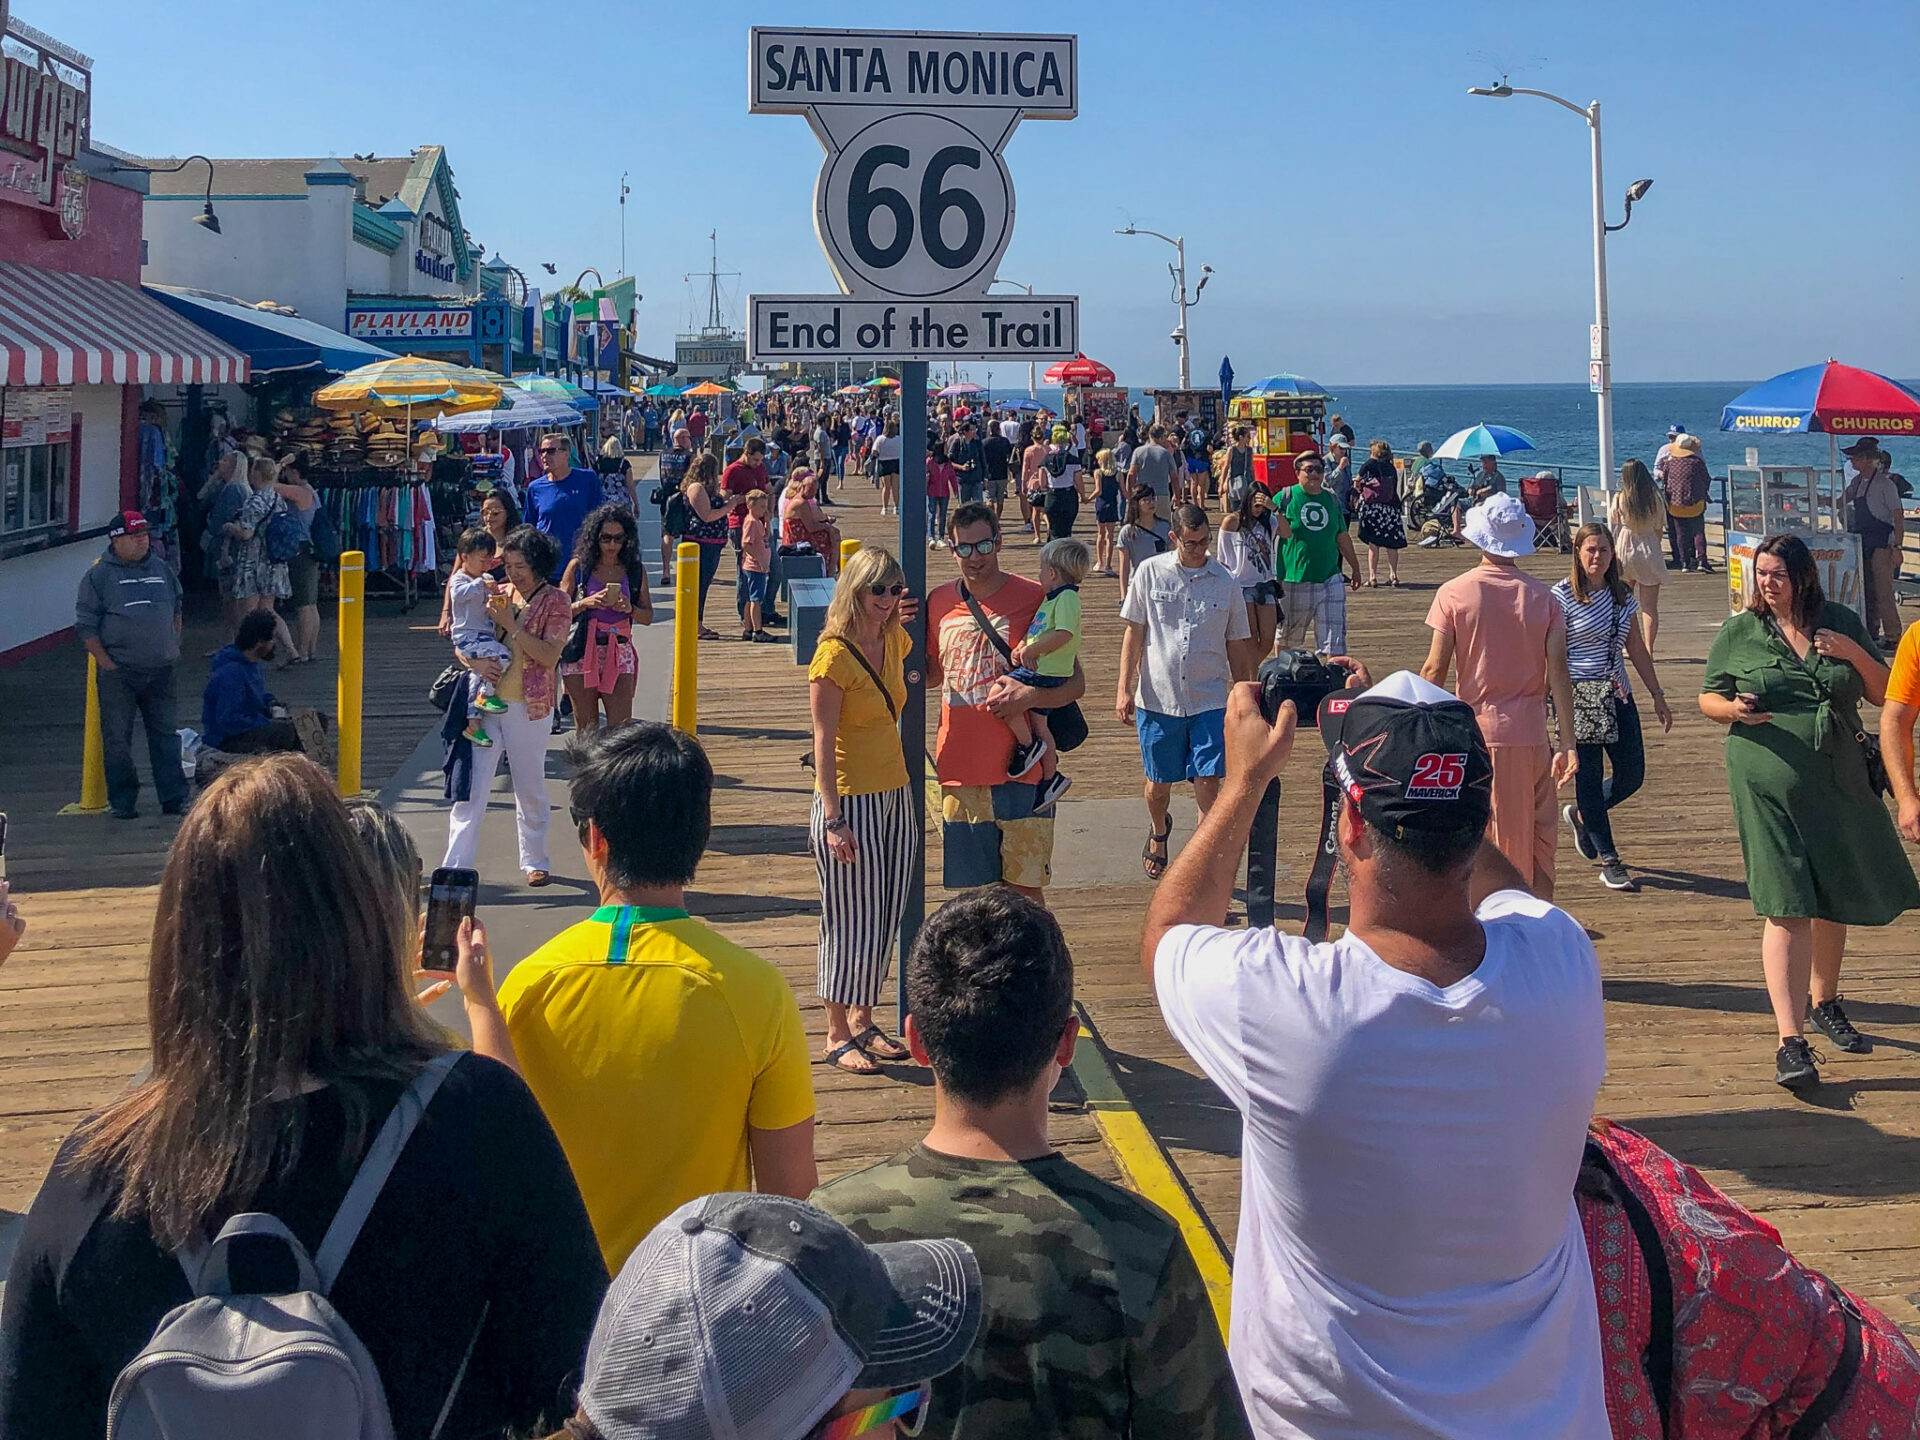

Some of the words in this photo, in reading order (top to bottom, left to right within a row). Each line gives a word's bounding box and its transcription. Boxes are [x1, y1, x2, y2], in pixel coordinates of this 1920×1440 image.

[766, 44, 891, 93] SANTA
[908, 51, 1064, 98] MONICA
[0, 57, 88, 205] urger
[848, 144, 985, 269] 66
[352, 312, 470, 328] PLAYLAND
[369, 328, 452, 336] ARCADE
[769, 307, 841, 349] End
[856, 307, 896, 349] of
[909, 307, 968, 349] the
[981, 307, 1061, 348] Trail
[1735, 415, 1801, 429] CHURROS
[1831, 417, 1914, 430] CHURROS
[1409, 753, 1467, 788] 25
[1407, 788, 1459, 798] MAVERICK
[1325, 801, 1339, 854] Canon
